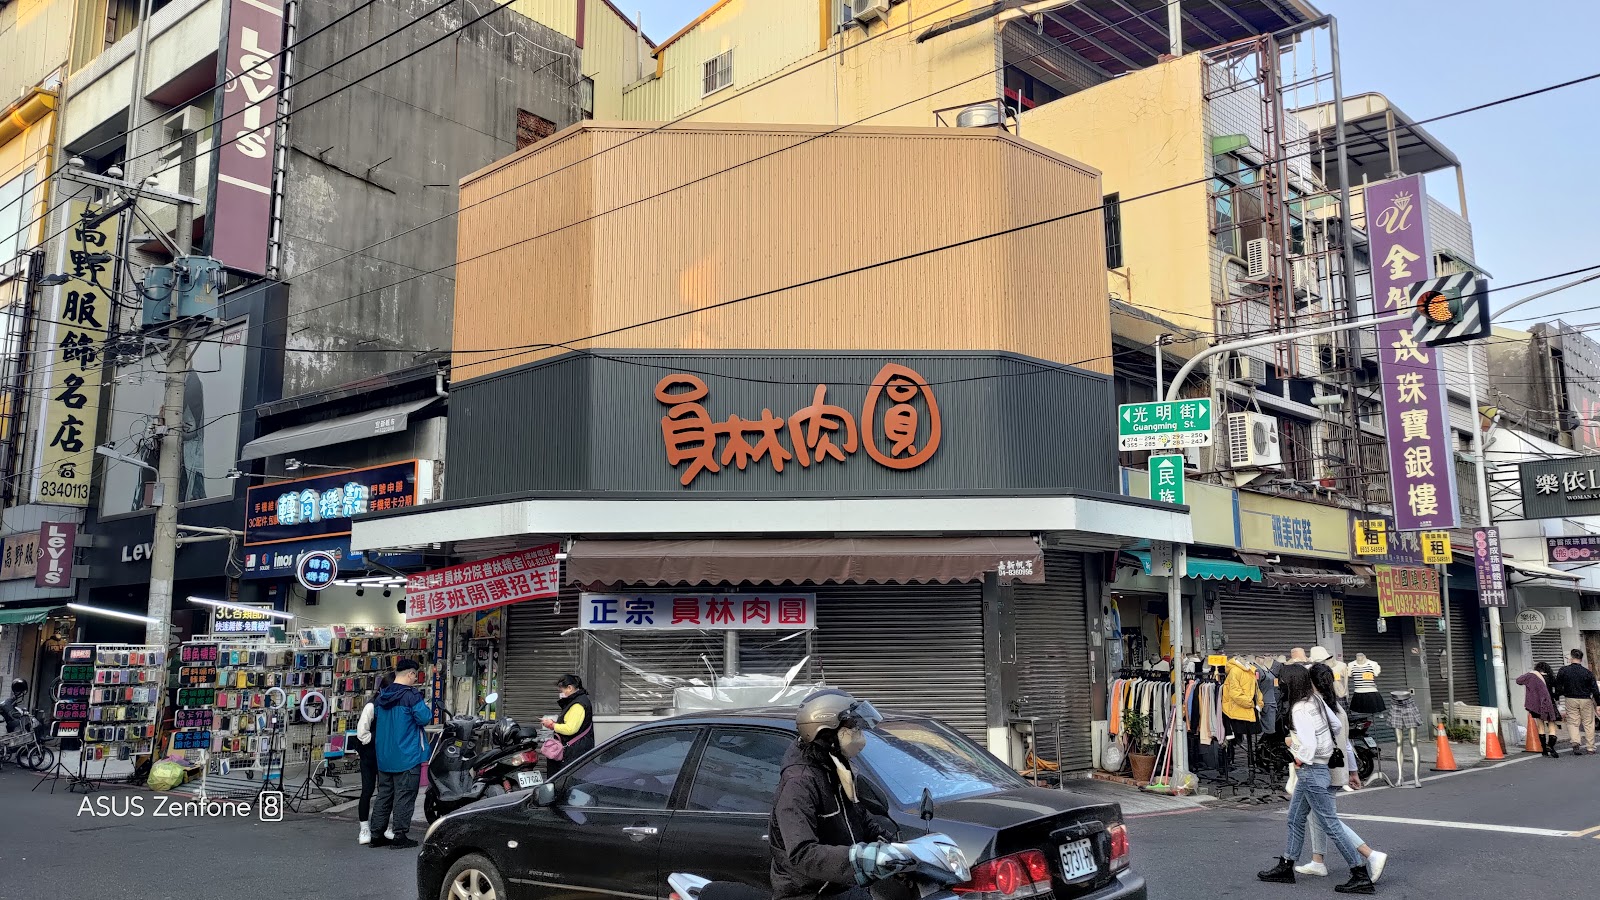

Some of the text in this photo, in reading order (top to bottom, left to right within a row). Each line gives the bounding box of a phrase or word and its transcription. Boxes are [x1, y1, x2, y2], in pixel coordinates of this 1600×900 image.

[236, 26, 275, 158] Levi's
[654, 362, 941, 486] 員林肉圓
[1133, 404, 1196, 423] 光明街
[1133, 420, 1196, 432] Guangming St.
[41, 481, 88, 499] 8340113
[45, 525, 67, 584] Levi's
[1430, 540, 1445, 555] 租
[409, 566, 558, 616] 禪修班開課招生中
[1377, 571, 1396, 614] 租
[590, 597, 807, 625] 正宗 員林肉圓
